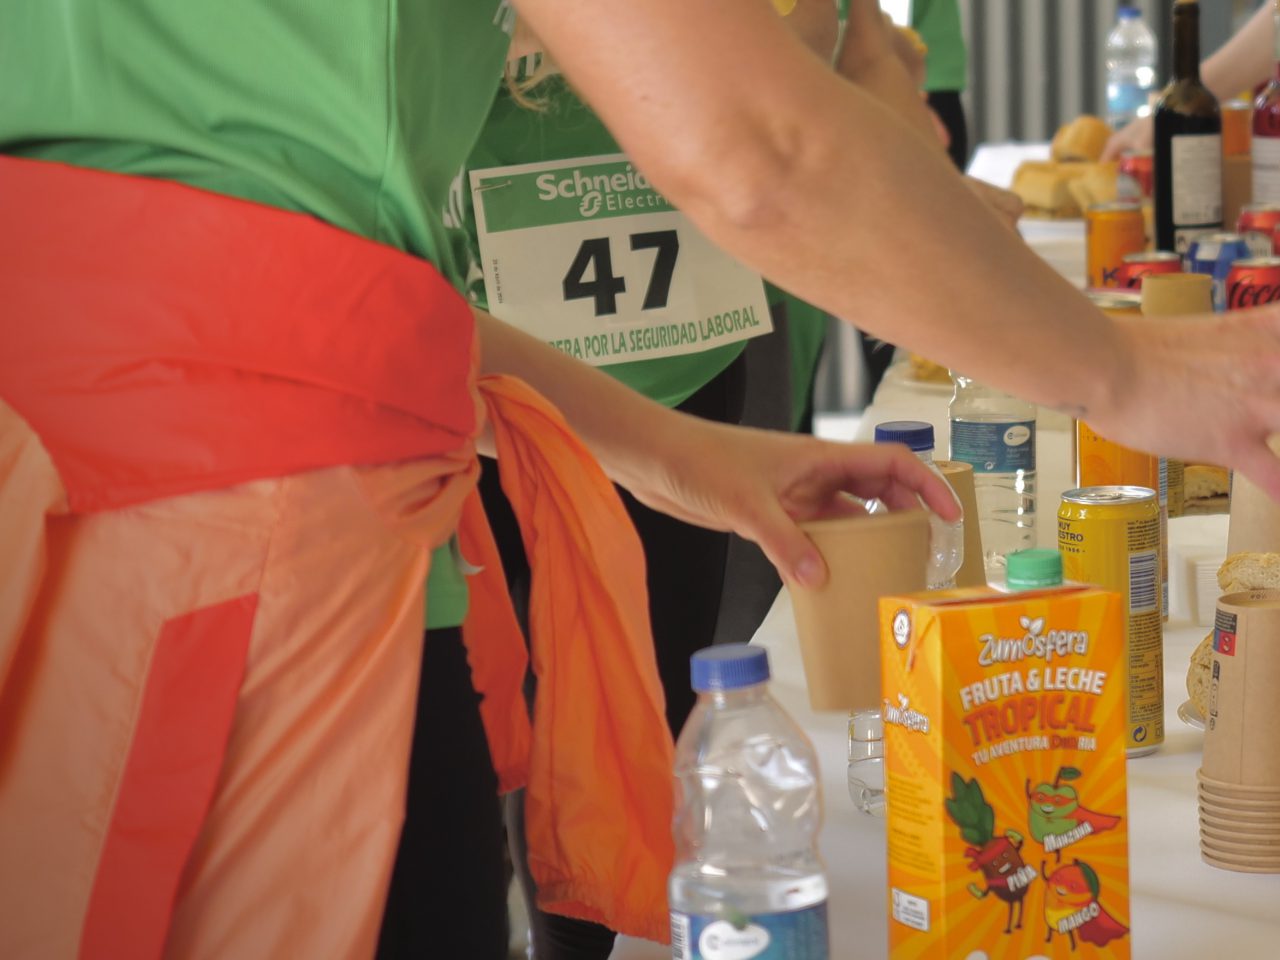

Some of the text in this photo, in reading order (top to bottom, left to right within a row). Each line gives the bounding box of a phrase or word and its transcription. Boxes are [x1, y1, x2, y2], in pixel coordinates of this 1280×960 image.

[562, 228, 680, 317] 47
[584, 332, 609, 359] POR
[611, 331, 628, 355] LA
[629, 321, 698, 353] SEGURIDAD
[698, 305, 760, 340] LABORAL
[977, 629, 1089, 667] Zumosfera
[960, 666, 1107, 712] FRUTA & LECHE
[962, 693, 1097, 747] TROPICAL
[972, 748, 990, 767] TU
[990, 735, 1050, 760] AVENTURA
[1006, 864, 1038, 893] PIÑA
[1058, 901, 1101, 934] MANGO
